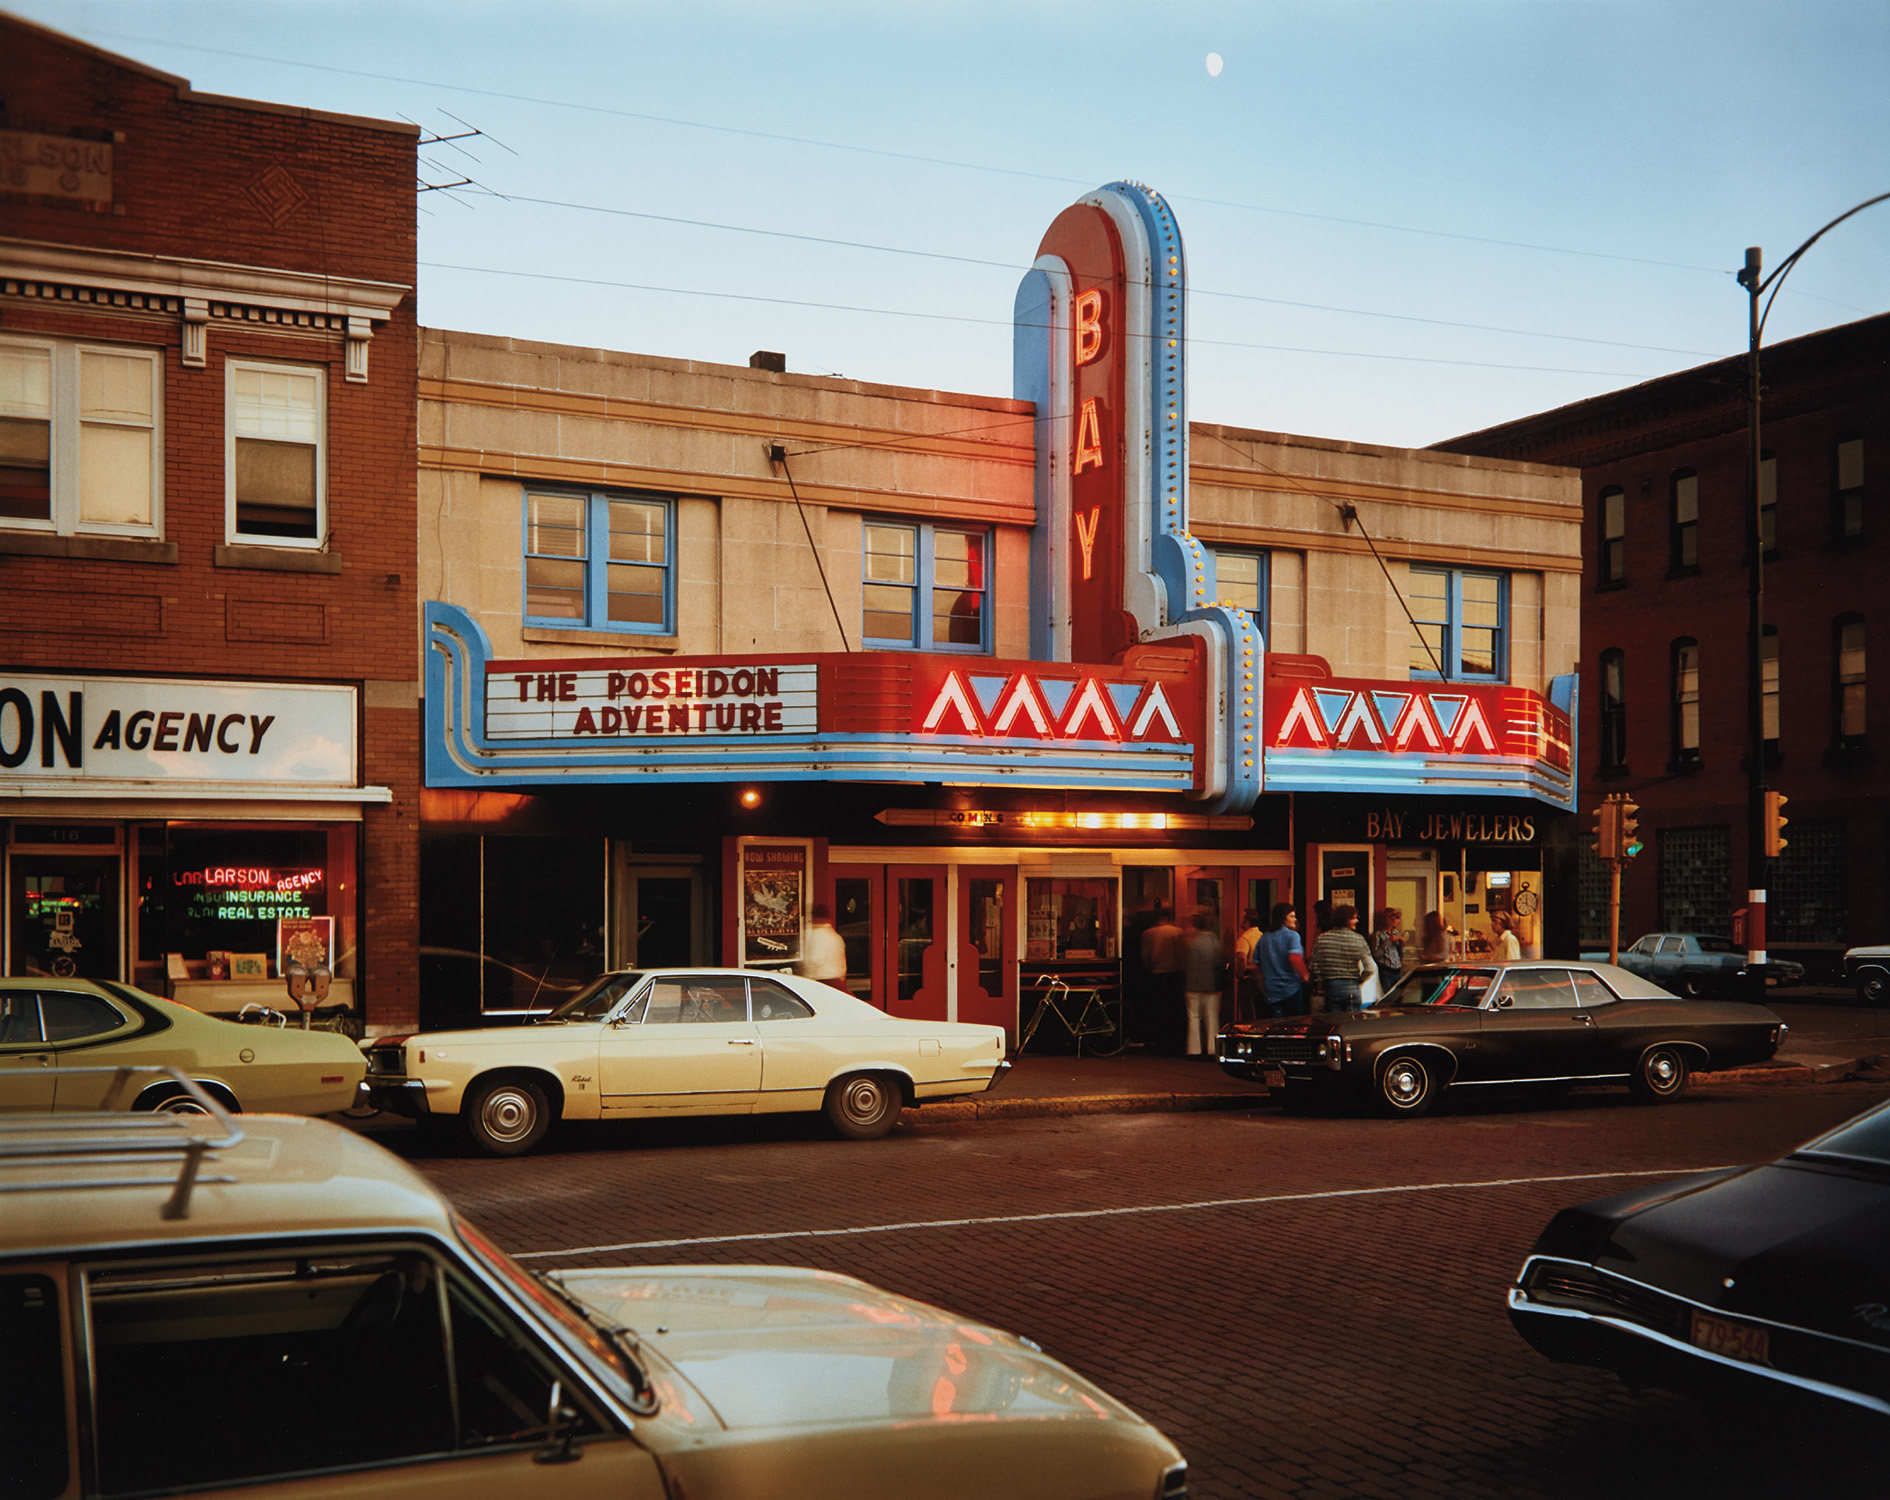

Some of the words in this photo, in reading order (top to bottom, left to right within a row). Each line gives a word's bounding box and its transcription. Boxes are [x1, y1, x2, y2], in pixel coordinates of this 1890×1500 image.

[1074, 288, 1103, 581] BAY
[514, 673, 577, 702] THE
[607, 667, 779, 700] POSEIDON
[0, 687, 83, 769] ON
[93, 709, 276, 755] AGENCY
[573, 702, 783, 734] ADVENTURE
[1366, 808, 1408, 839] BAY
[1419, 811, 1535, 841] JEWELERS
[204, 867, 271, 885] LARSON
[276, 869, 323, 892] AGENCY
[218, 906, 254, 919] REAL
[258, 906, 311, 919] ESTATE
[225, 890, 302, 903] INSURANCE
